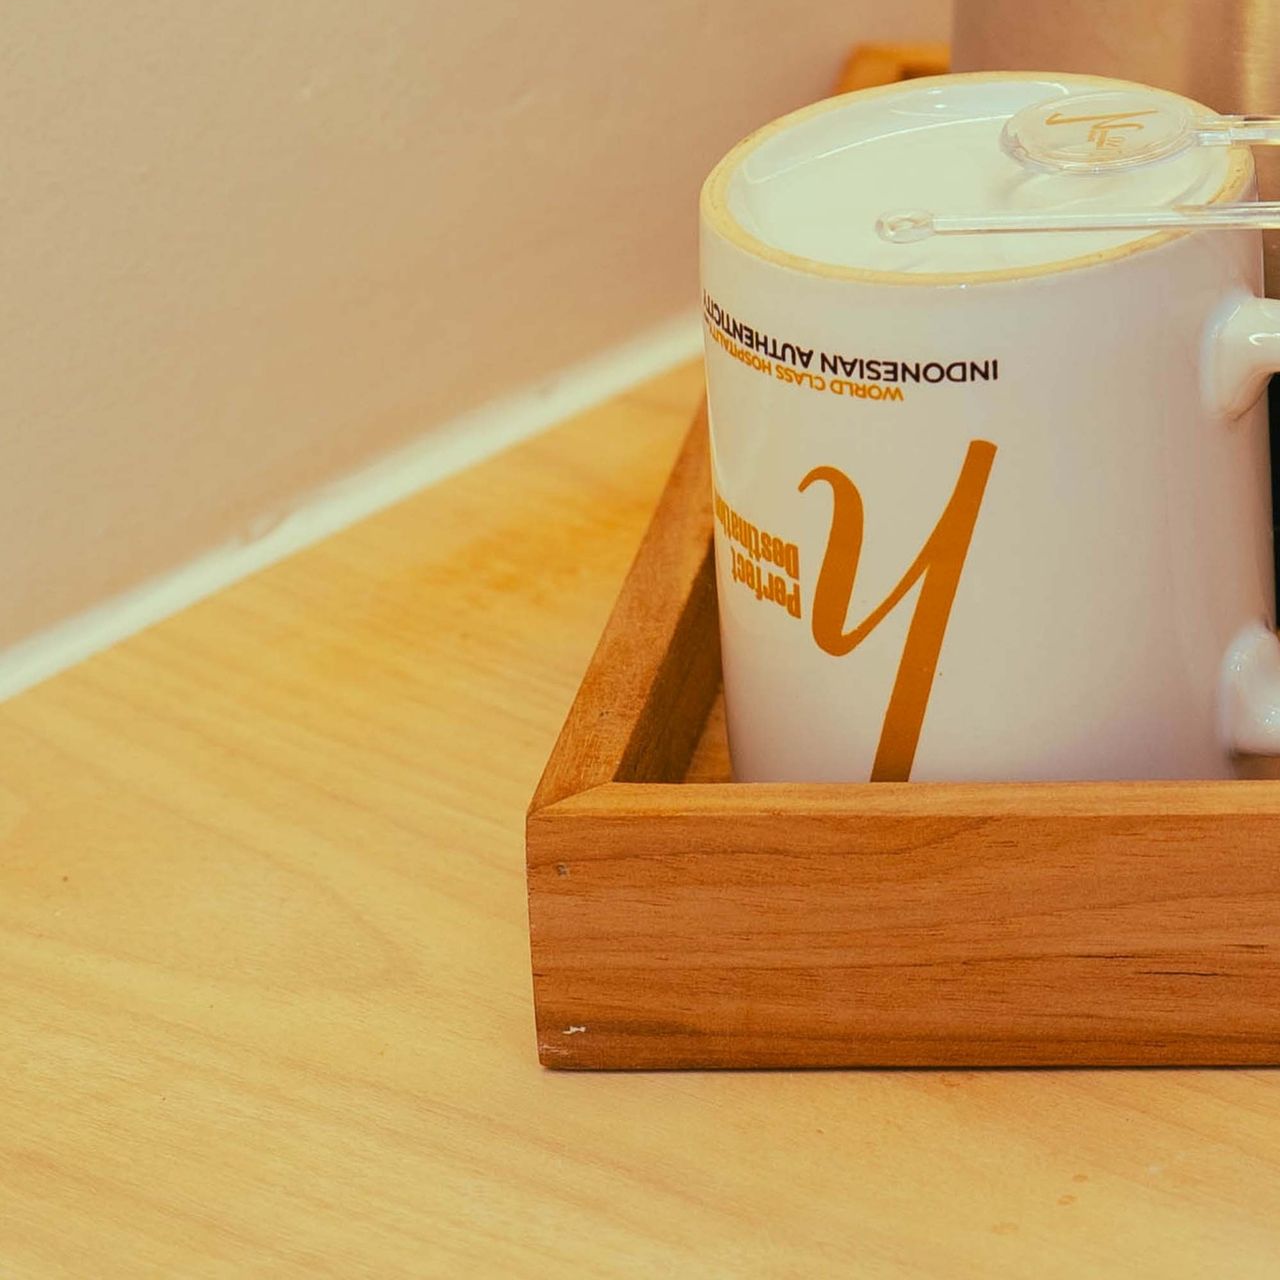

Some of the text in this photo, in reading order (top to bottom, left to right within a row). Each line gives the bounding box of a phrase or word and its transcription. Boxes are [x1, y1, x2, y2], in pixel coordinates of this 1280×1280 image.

[775, 365, 826, 391] CLASS
[820, 351, 999, 385] INDONESIAN
[830, 380, 905, 402] WORLD
[731, 545, 801, 620] Perfect
